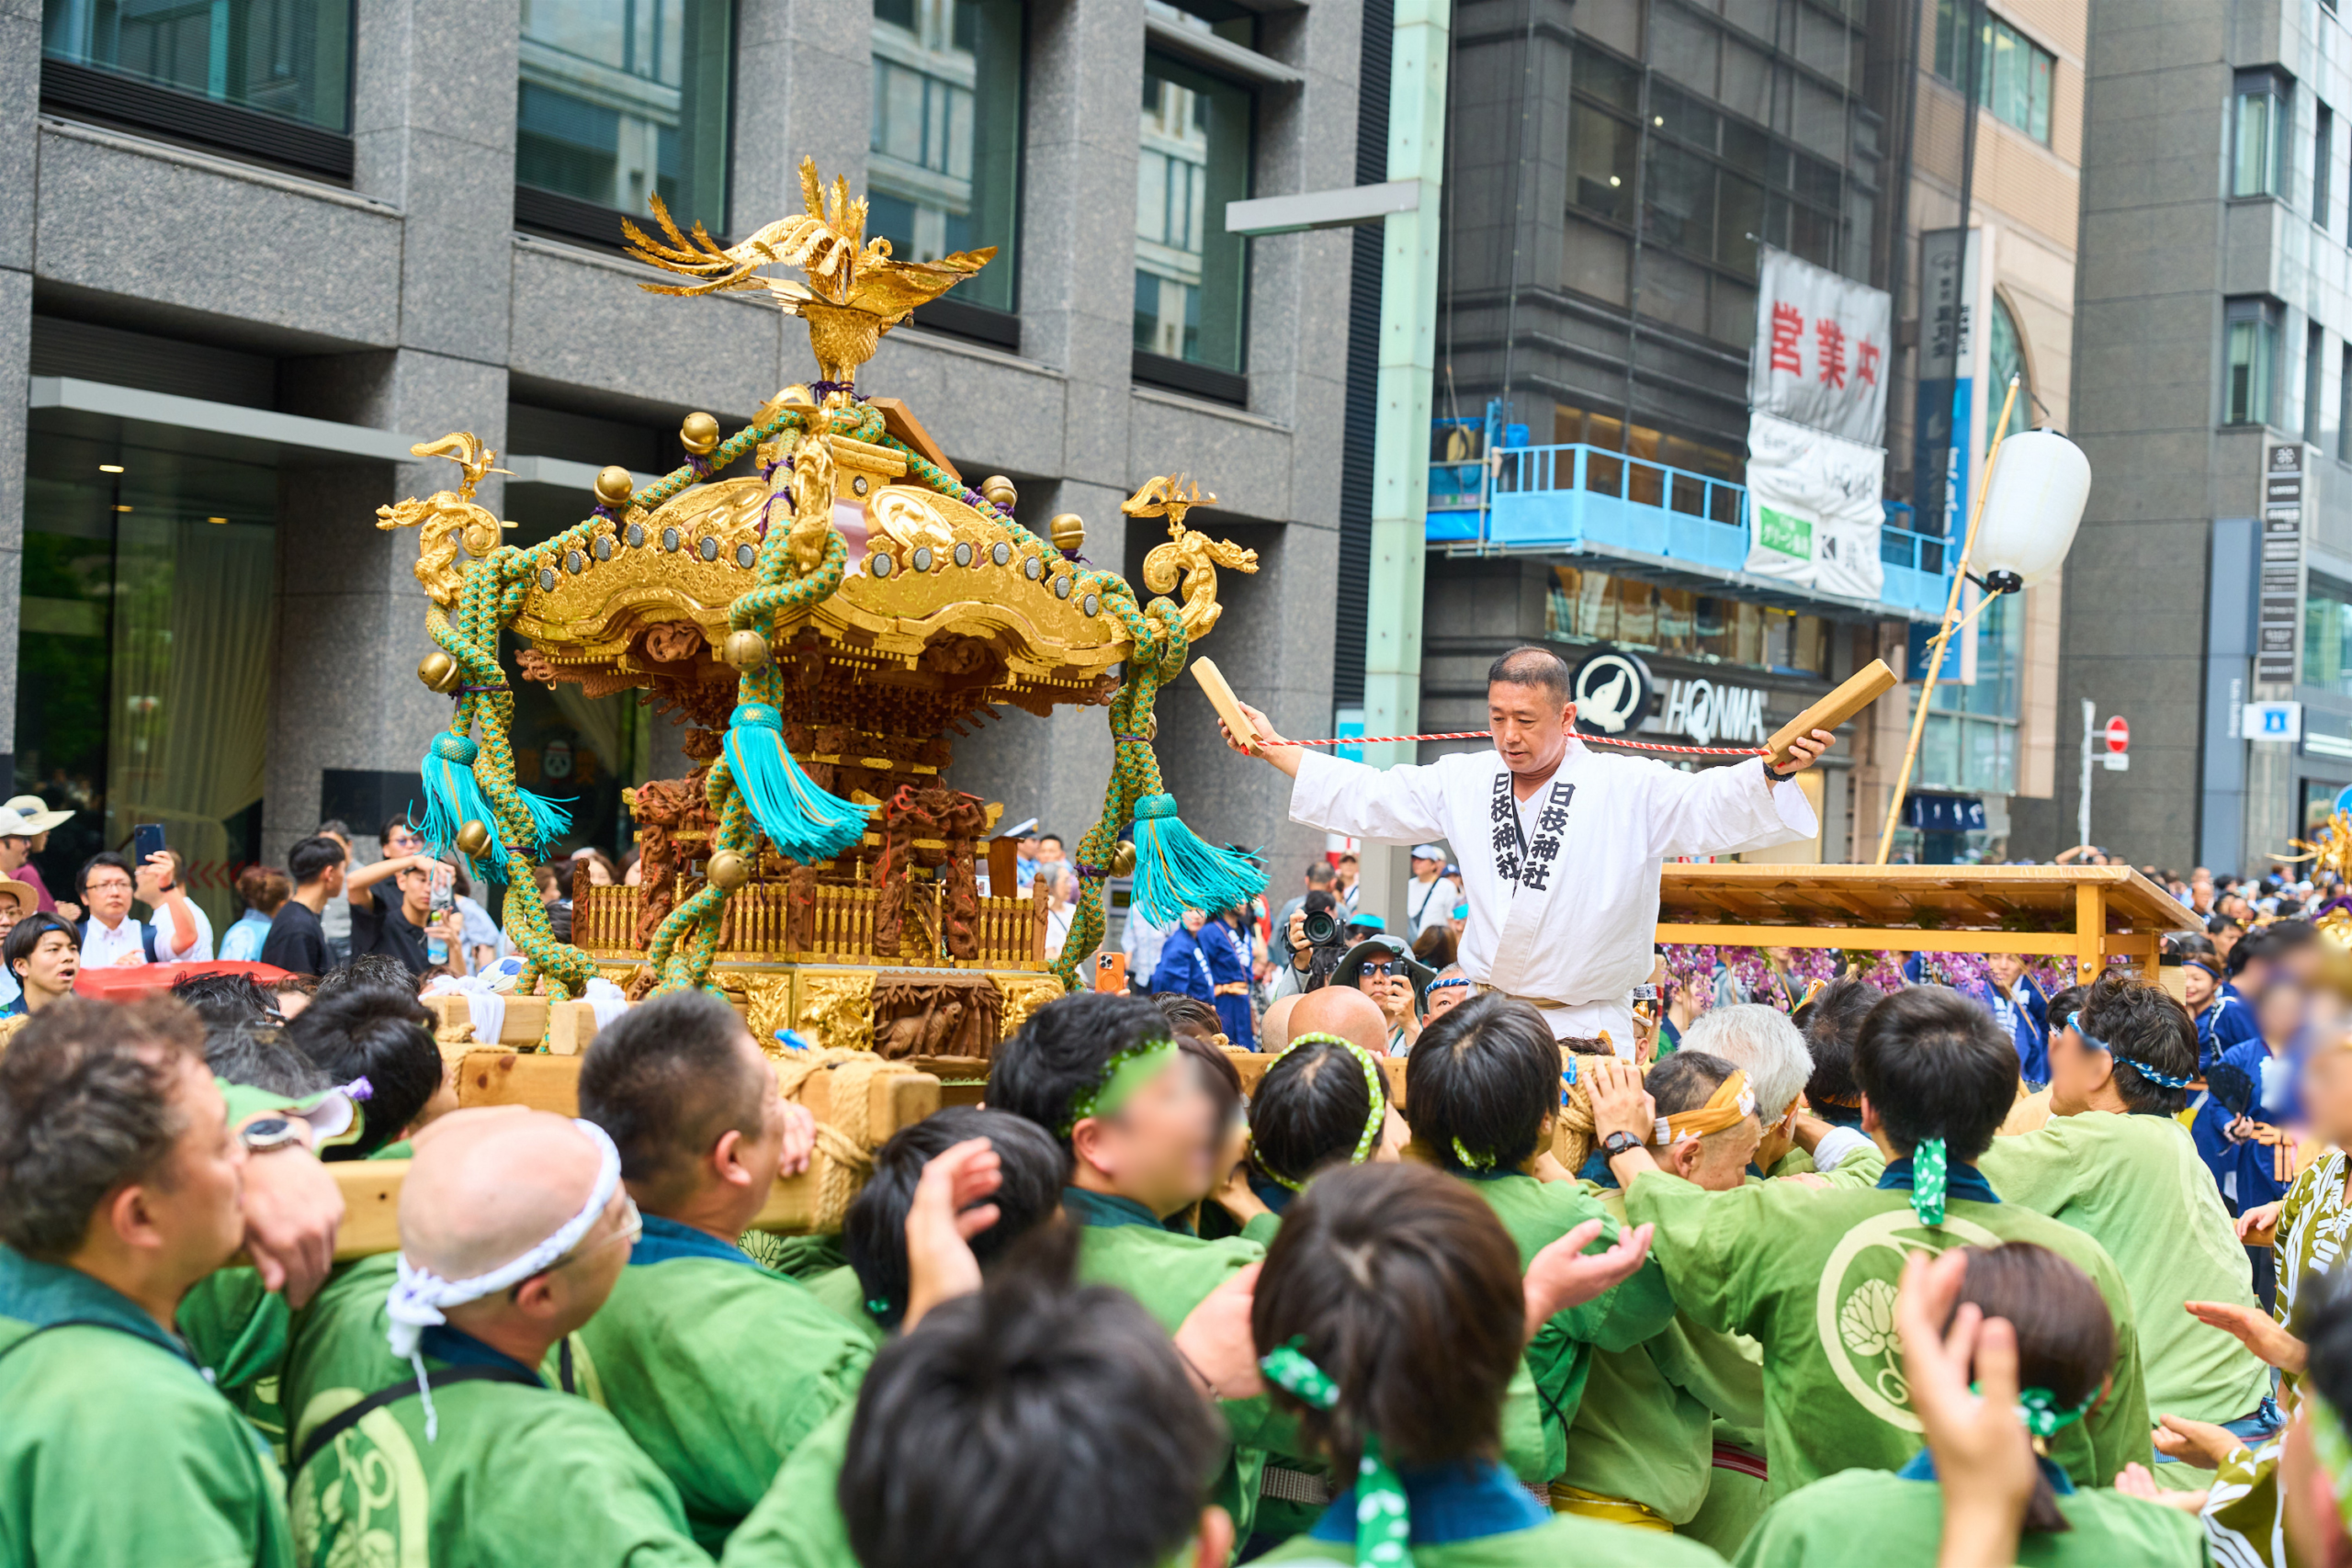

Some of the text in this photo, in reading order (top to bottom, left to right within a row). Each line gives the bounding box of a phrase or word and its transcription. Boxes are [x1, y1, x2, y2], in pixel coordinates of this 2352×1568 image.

[1770, 300, 1880, 400] 営業中
[1665, 679, 1765, 744] HONMA
[1491, 773, 1521, 880] 日枝神社
[1521, 782, 1576, 891] 日枝神社
